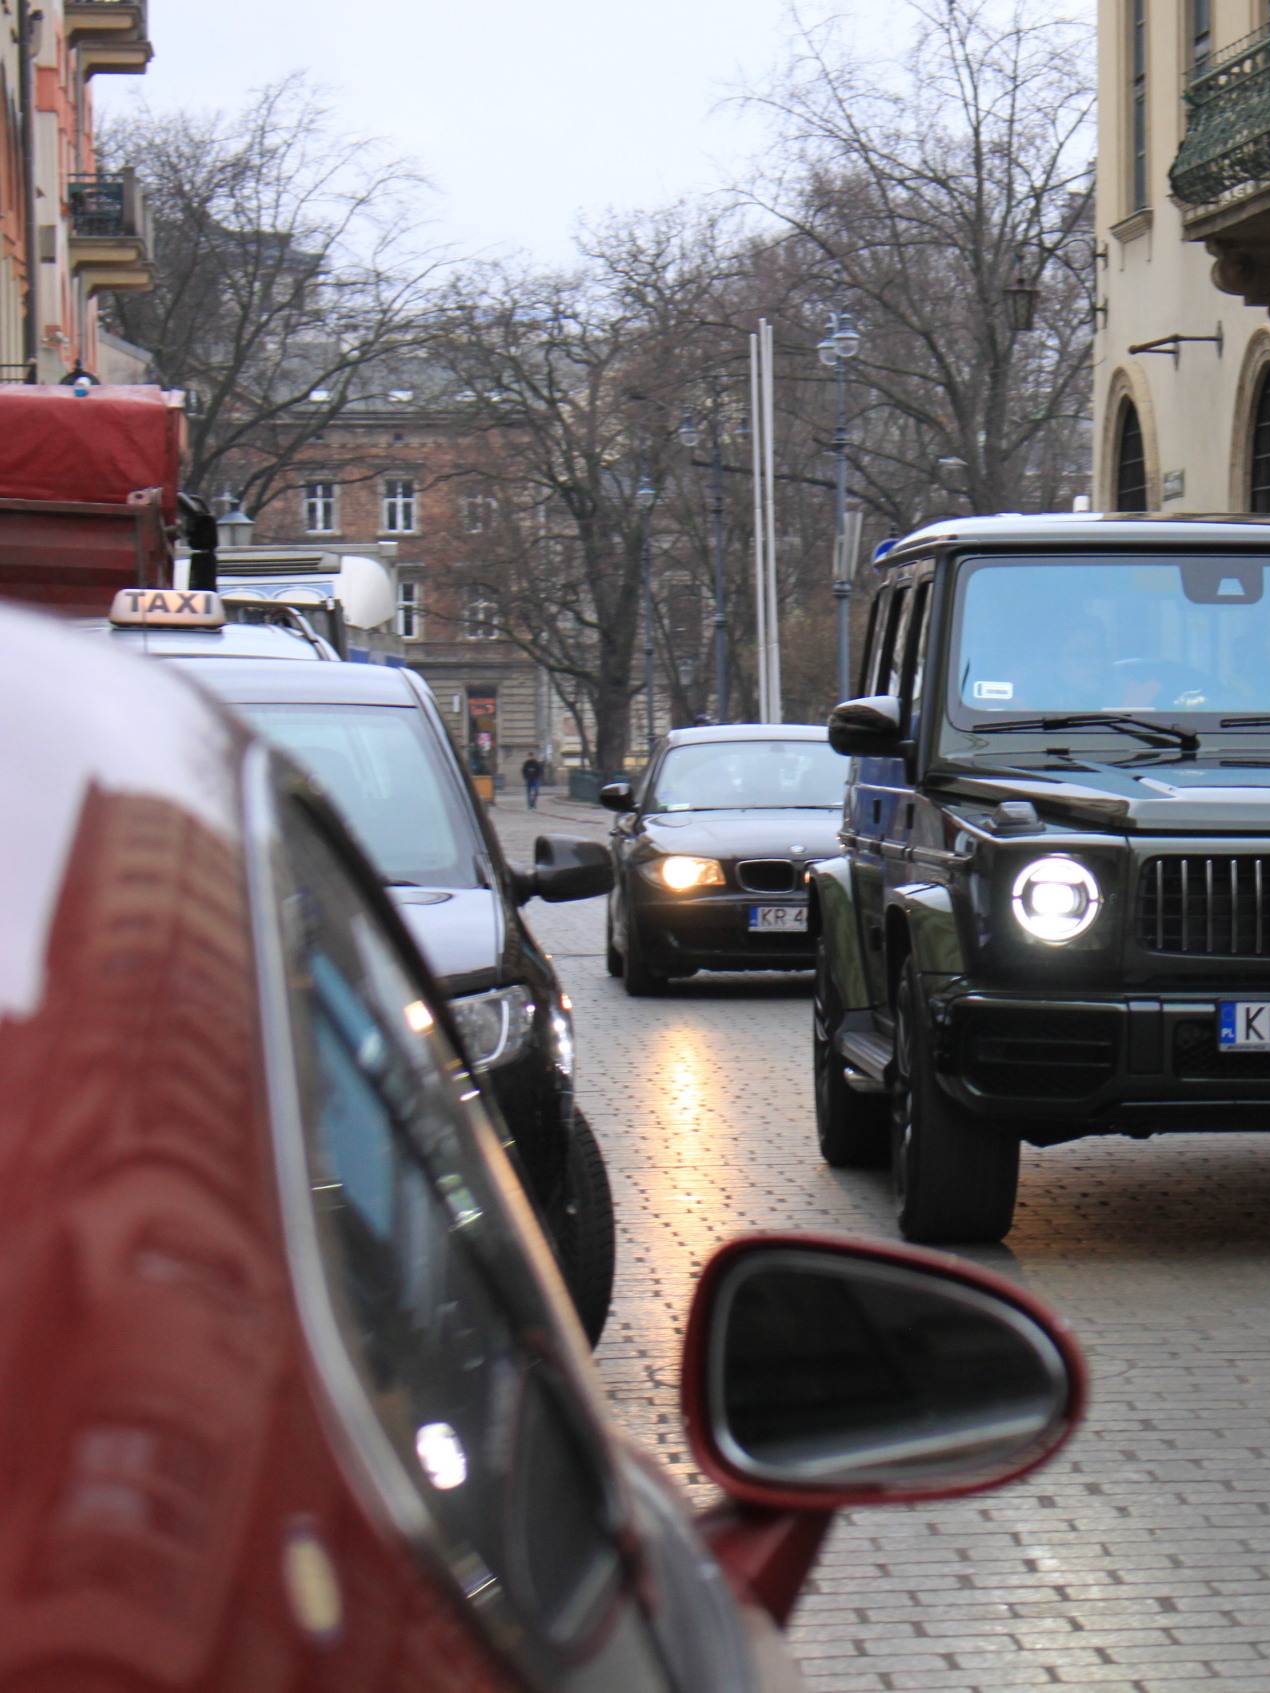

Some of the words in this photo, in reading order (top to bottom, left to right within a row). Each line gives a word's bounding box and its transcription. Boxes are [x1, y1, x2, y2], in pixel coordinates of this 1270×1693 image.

[125, 591, 213, 614] TAXI
[761, 908, 787, 926] KR
[1221, 1028, 1234, 1038] PL
